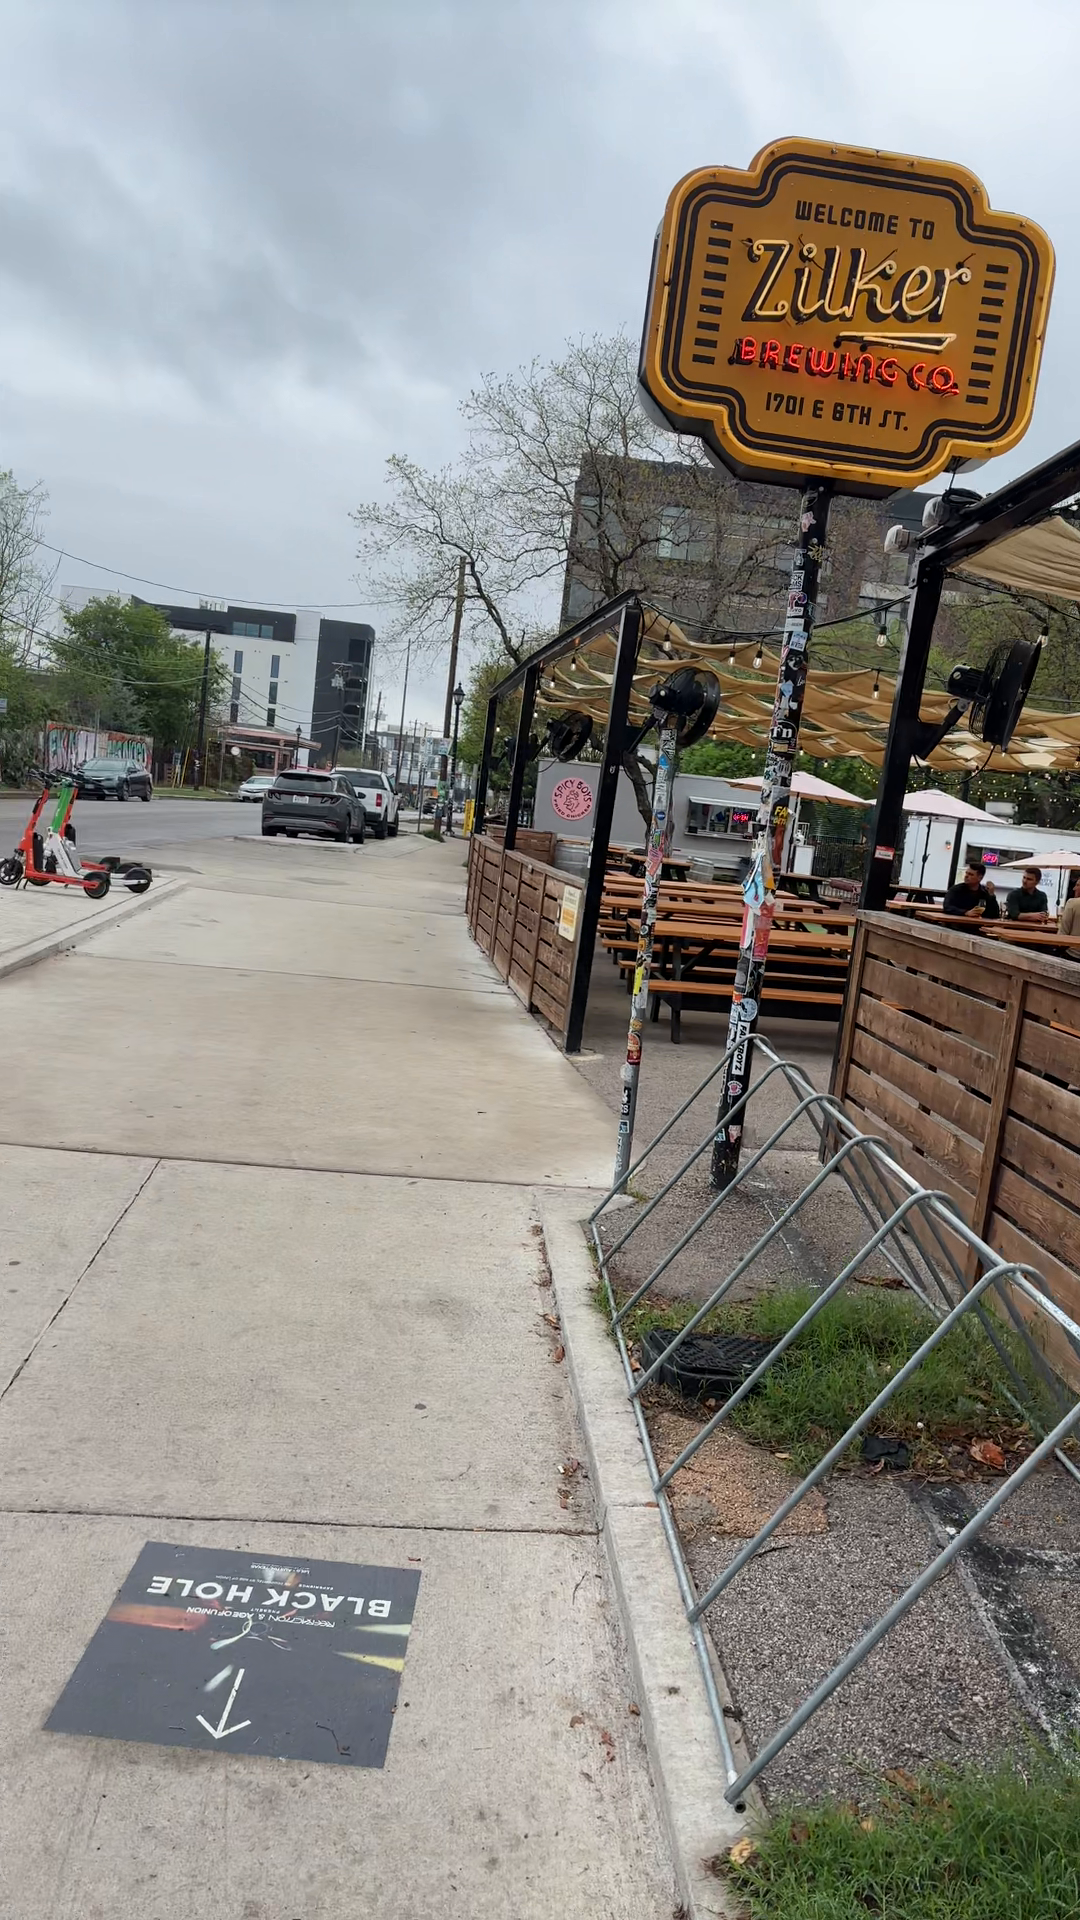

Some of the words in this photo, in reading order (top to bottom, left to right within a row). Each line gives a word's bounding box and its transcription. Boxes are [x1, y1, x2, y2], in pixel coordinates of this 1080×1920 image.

[795, 200, 899, 235] WELCOME
[909, 217, 936, 241] TO
[742, 238, 973, 324] Zilker
[737, 336, 898, 387] BREWING
[765, 392, 804, 416] 1701
[812, 400, 825, 419] E
[832, 403, 872, 426] 6TH
[879, 410, 909, 431] ST.
[554, 779, 576, 799] SPICY
[577, 780, 592, 802] BOYS
[146, 1574, 250, 1604] HOLE
[261, 1587, 392, 1618] BLACK
[298, 1583, 334, 1591] EXPERIENCE
